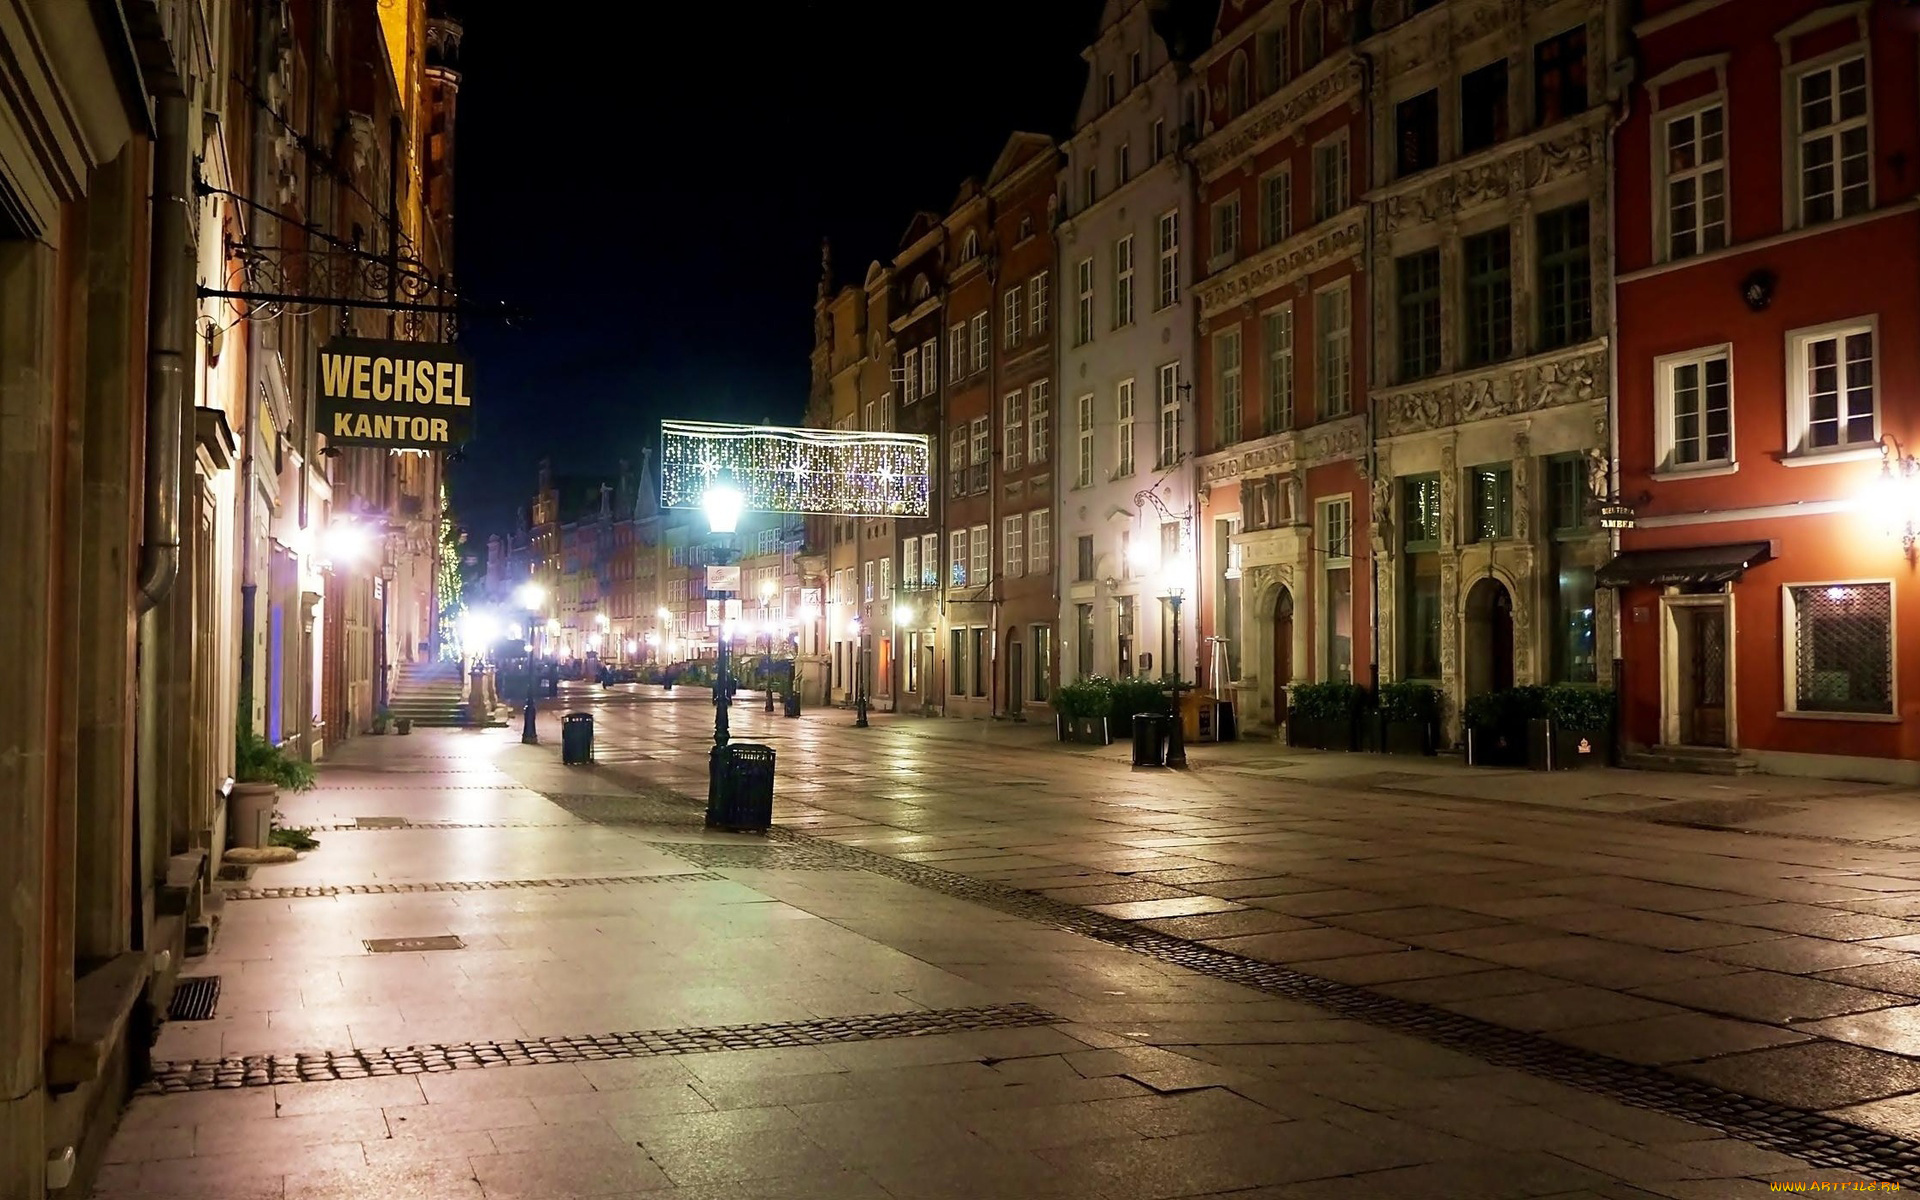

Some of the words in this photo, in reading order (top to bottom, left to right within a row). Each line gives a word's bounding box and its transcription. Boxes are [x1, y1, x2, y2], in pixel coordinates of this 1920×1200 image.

[321, 353, 471, 407] WECHSEL
[334, 412, 449, 442] KANTOR
[1600, 519, 1634, 528] AMBER
